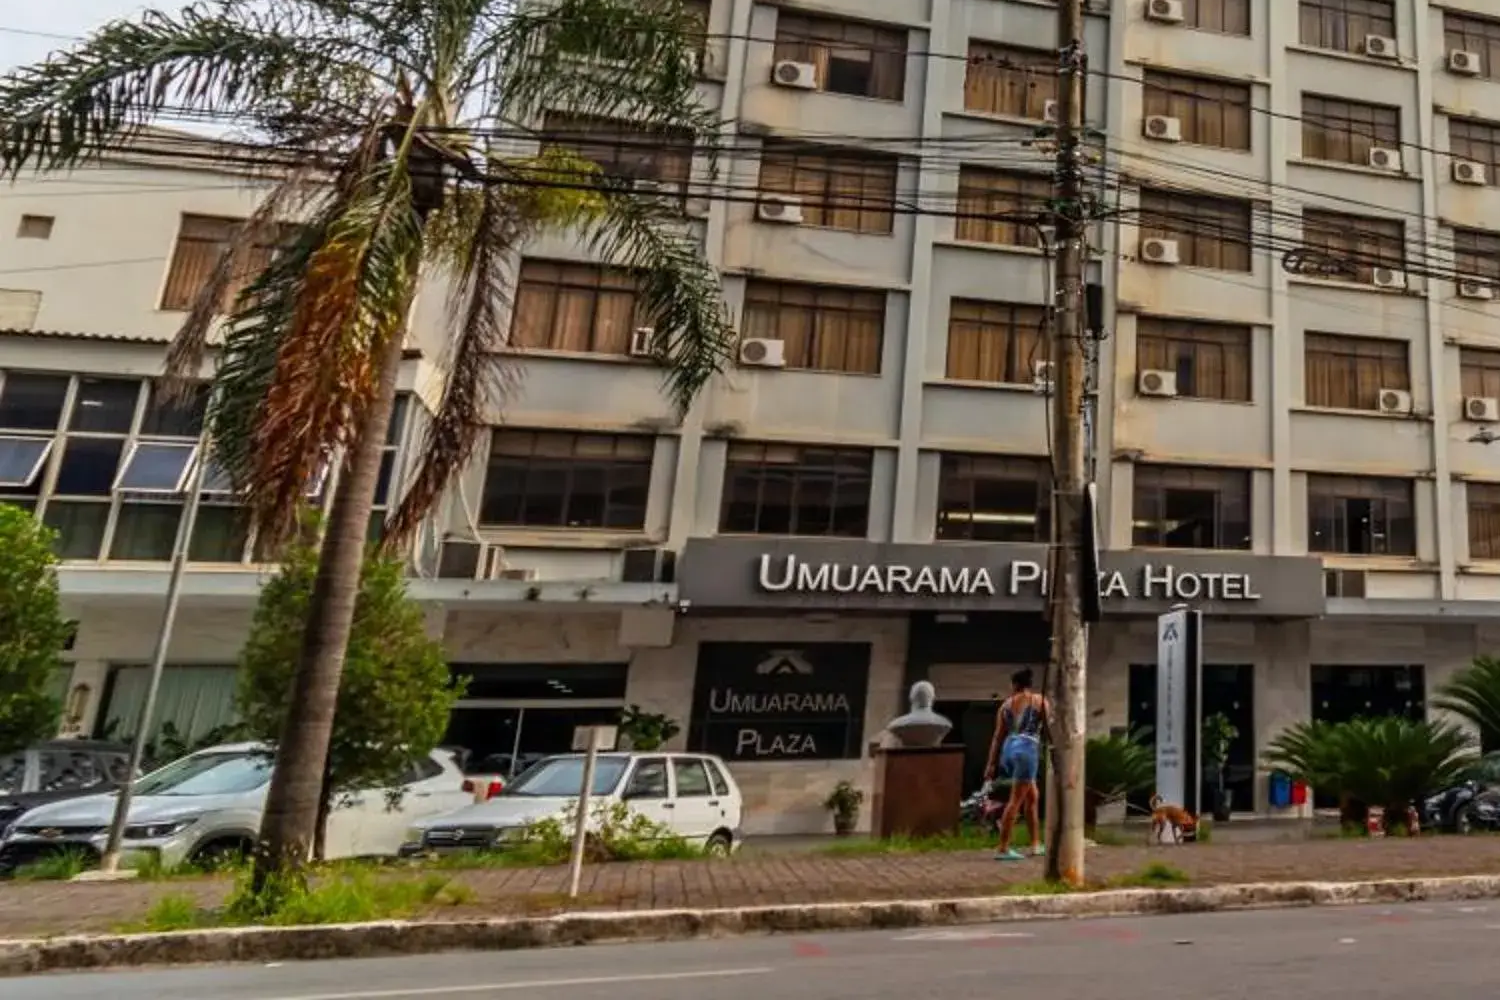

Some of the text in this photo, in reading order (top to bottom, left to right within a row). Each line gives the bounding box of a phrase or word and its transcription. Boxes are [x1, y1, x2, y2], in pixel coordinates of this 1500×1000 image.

[759, 553, 995, 595] UMUARAMA
[1144, 564, 1262, 599] HOTEL
[709, 687, 850, 713] UMUARAMA
[735, 728, 817, 755] PLAZA
